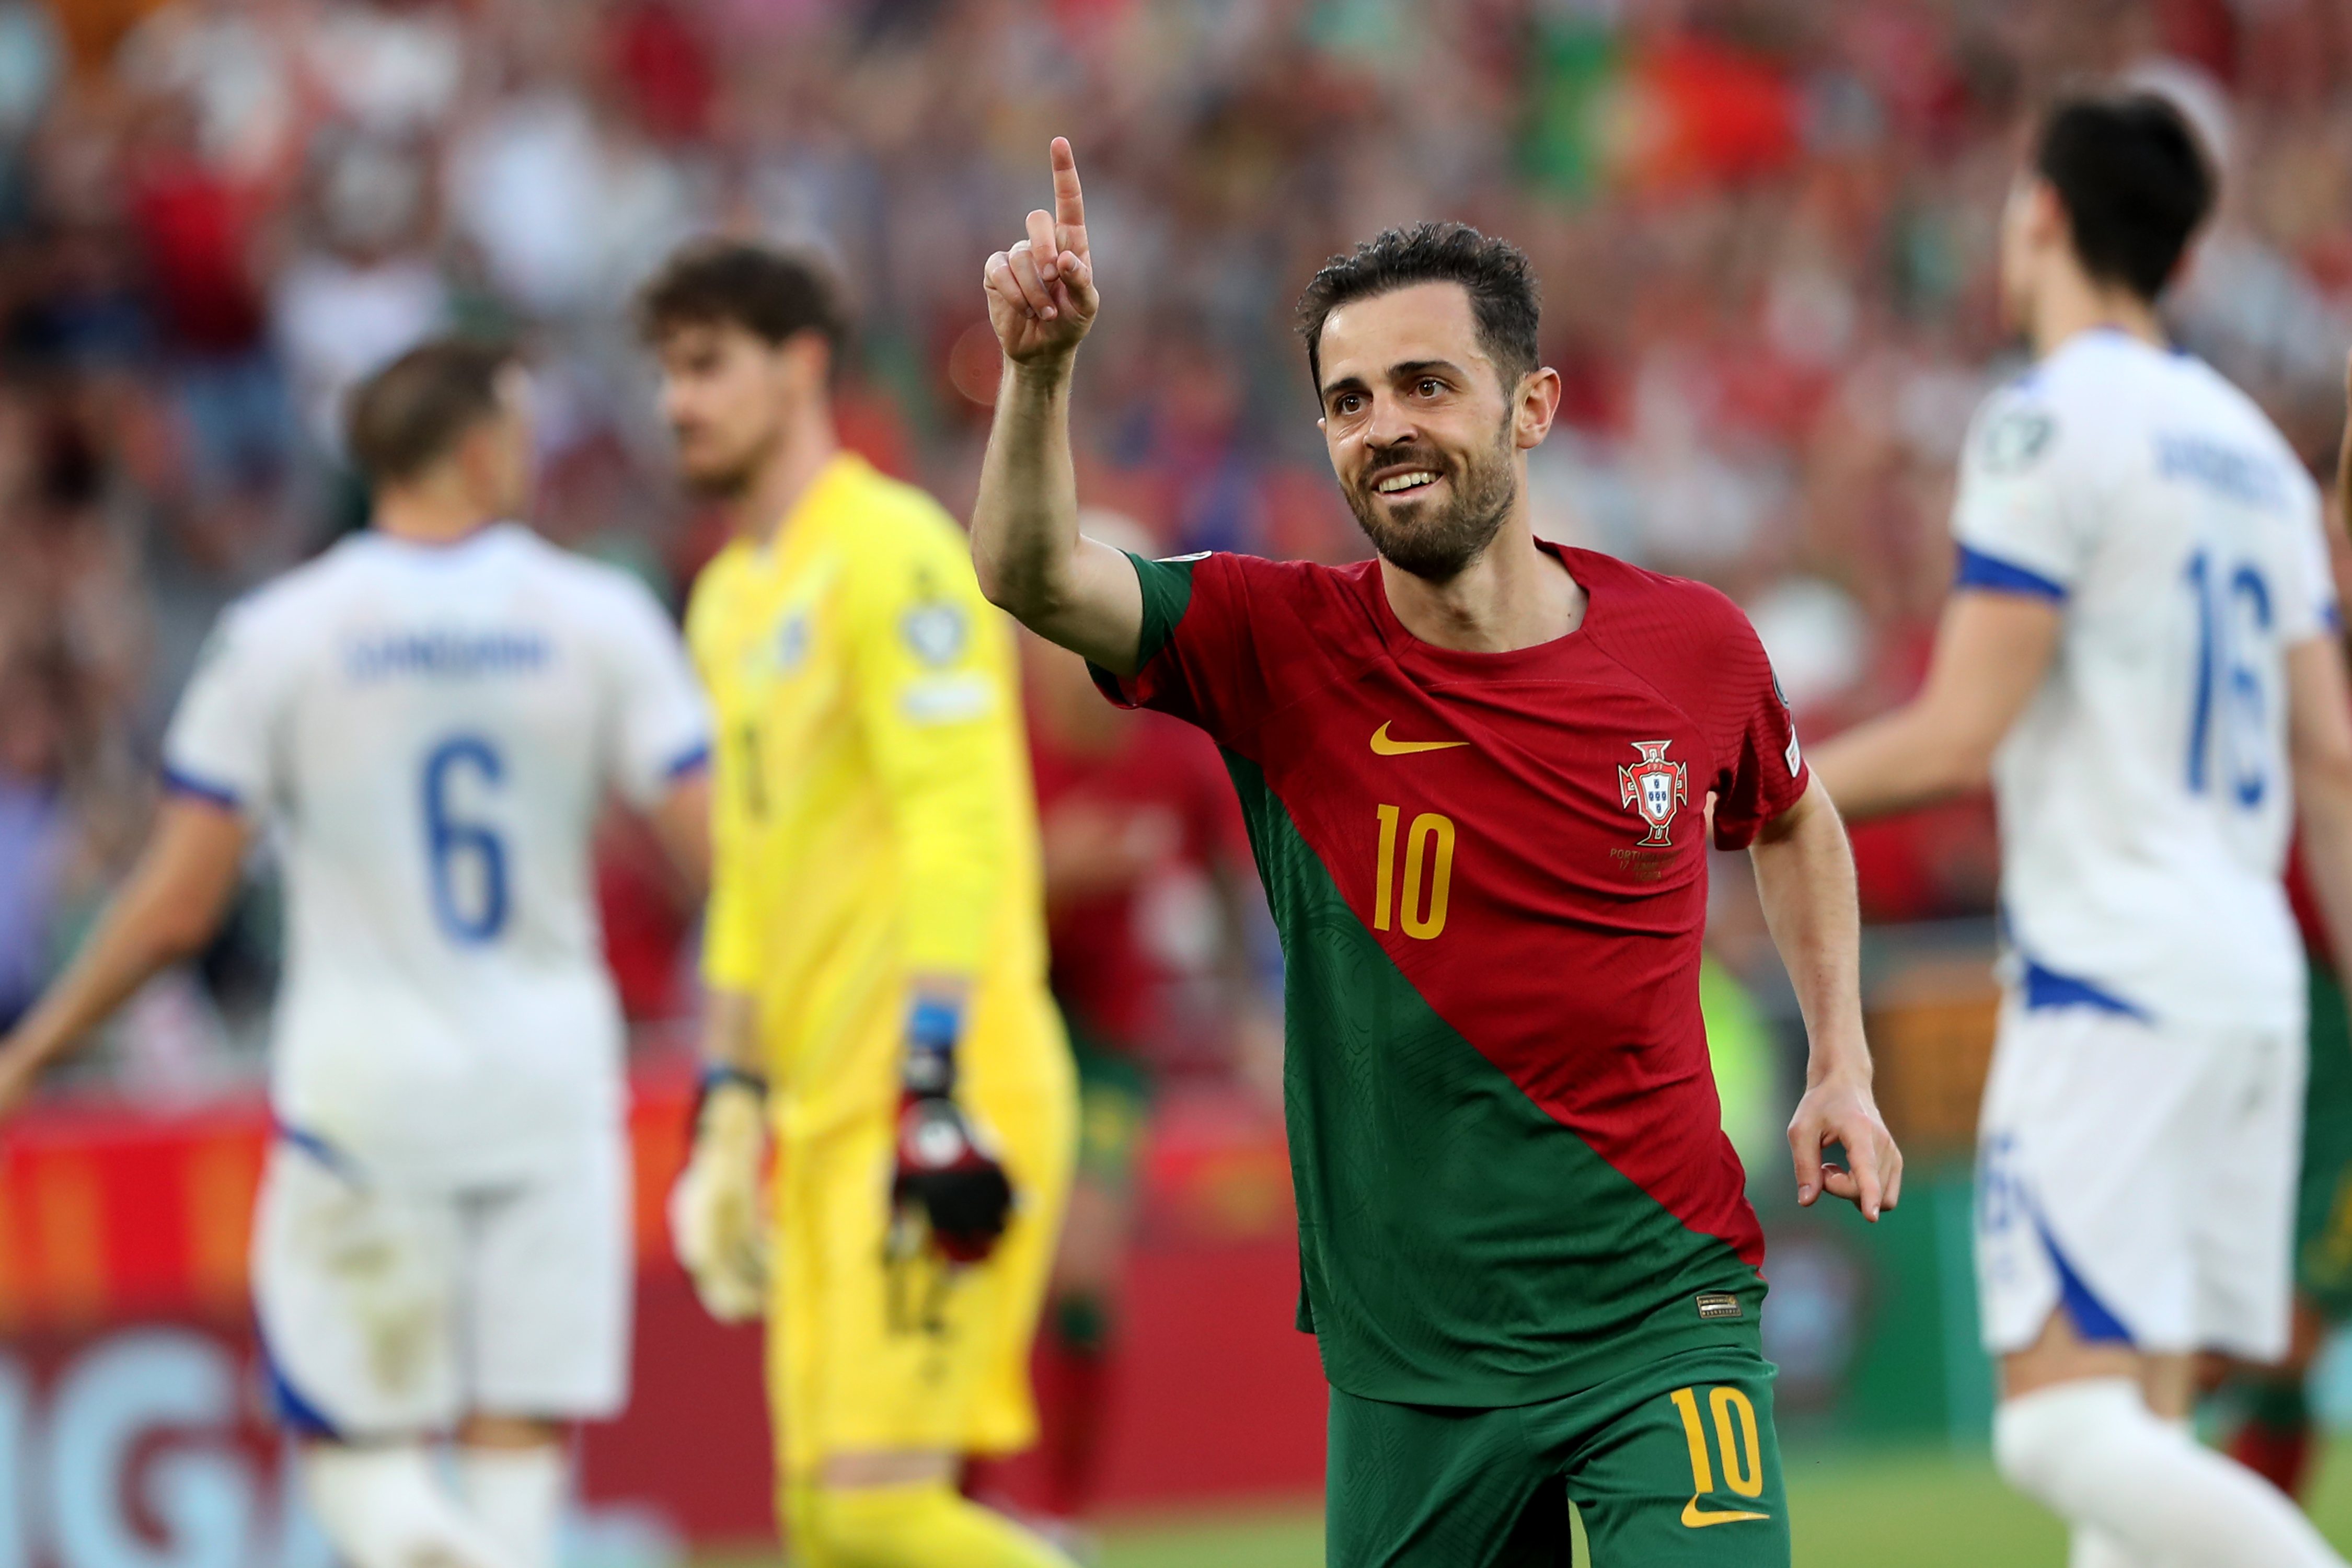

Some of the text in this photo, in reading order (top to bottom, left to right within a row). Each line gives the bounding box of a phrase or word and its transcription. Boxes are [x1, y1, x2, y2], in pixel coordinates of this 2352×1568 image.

[419, 732, 513, 946] 6
[1374, 804, 1455, 940] 10
[1670, 1387, 1762, 1497] 10
